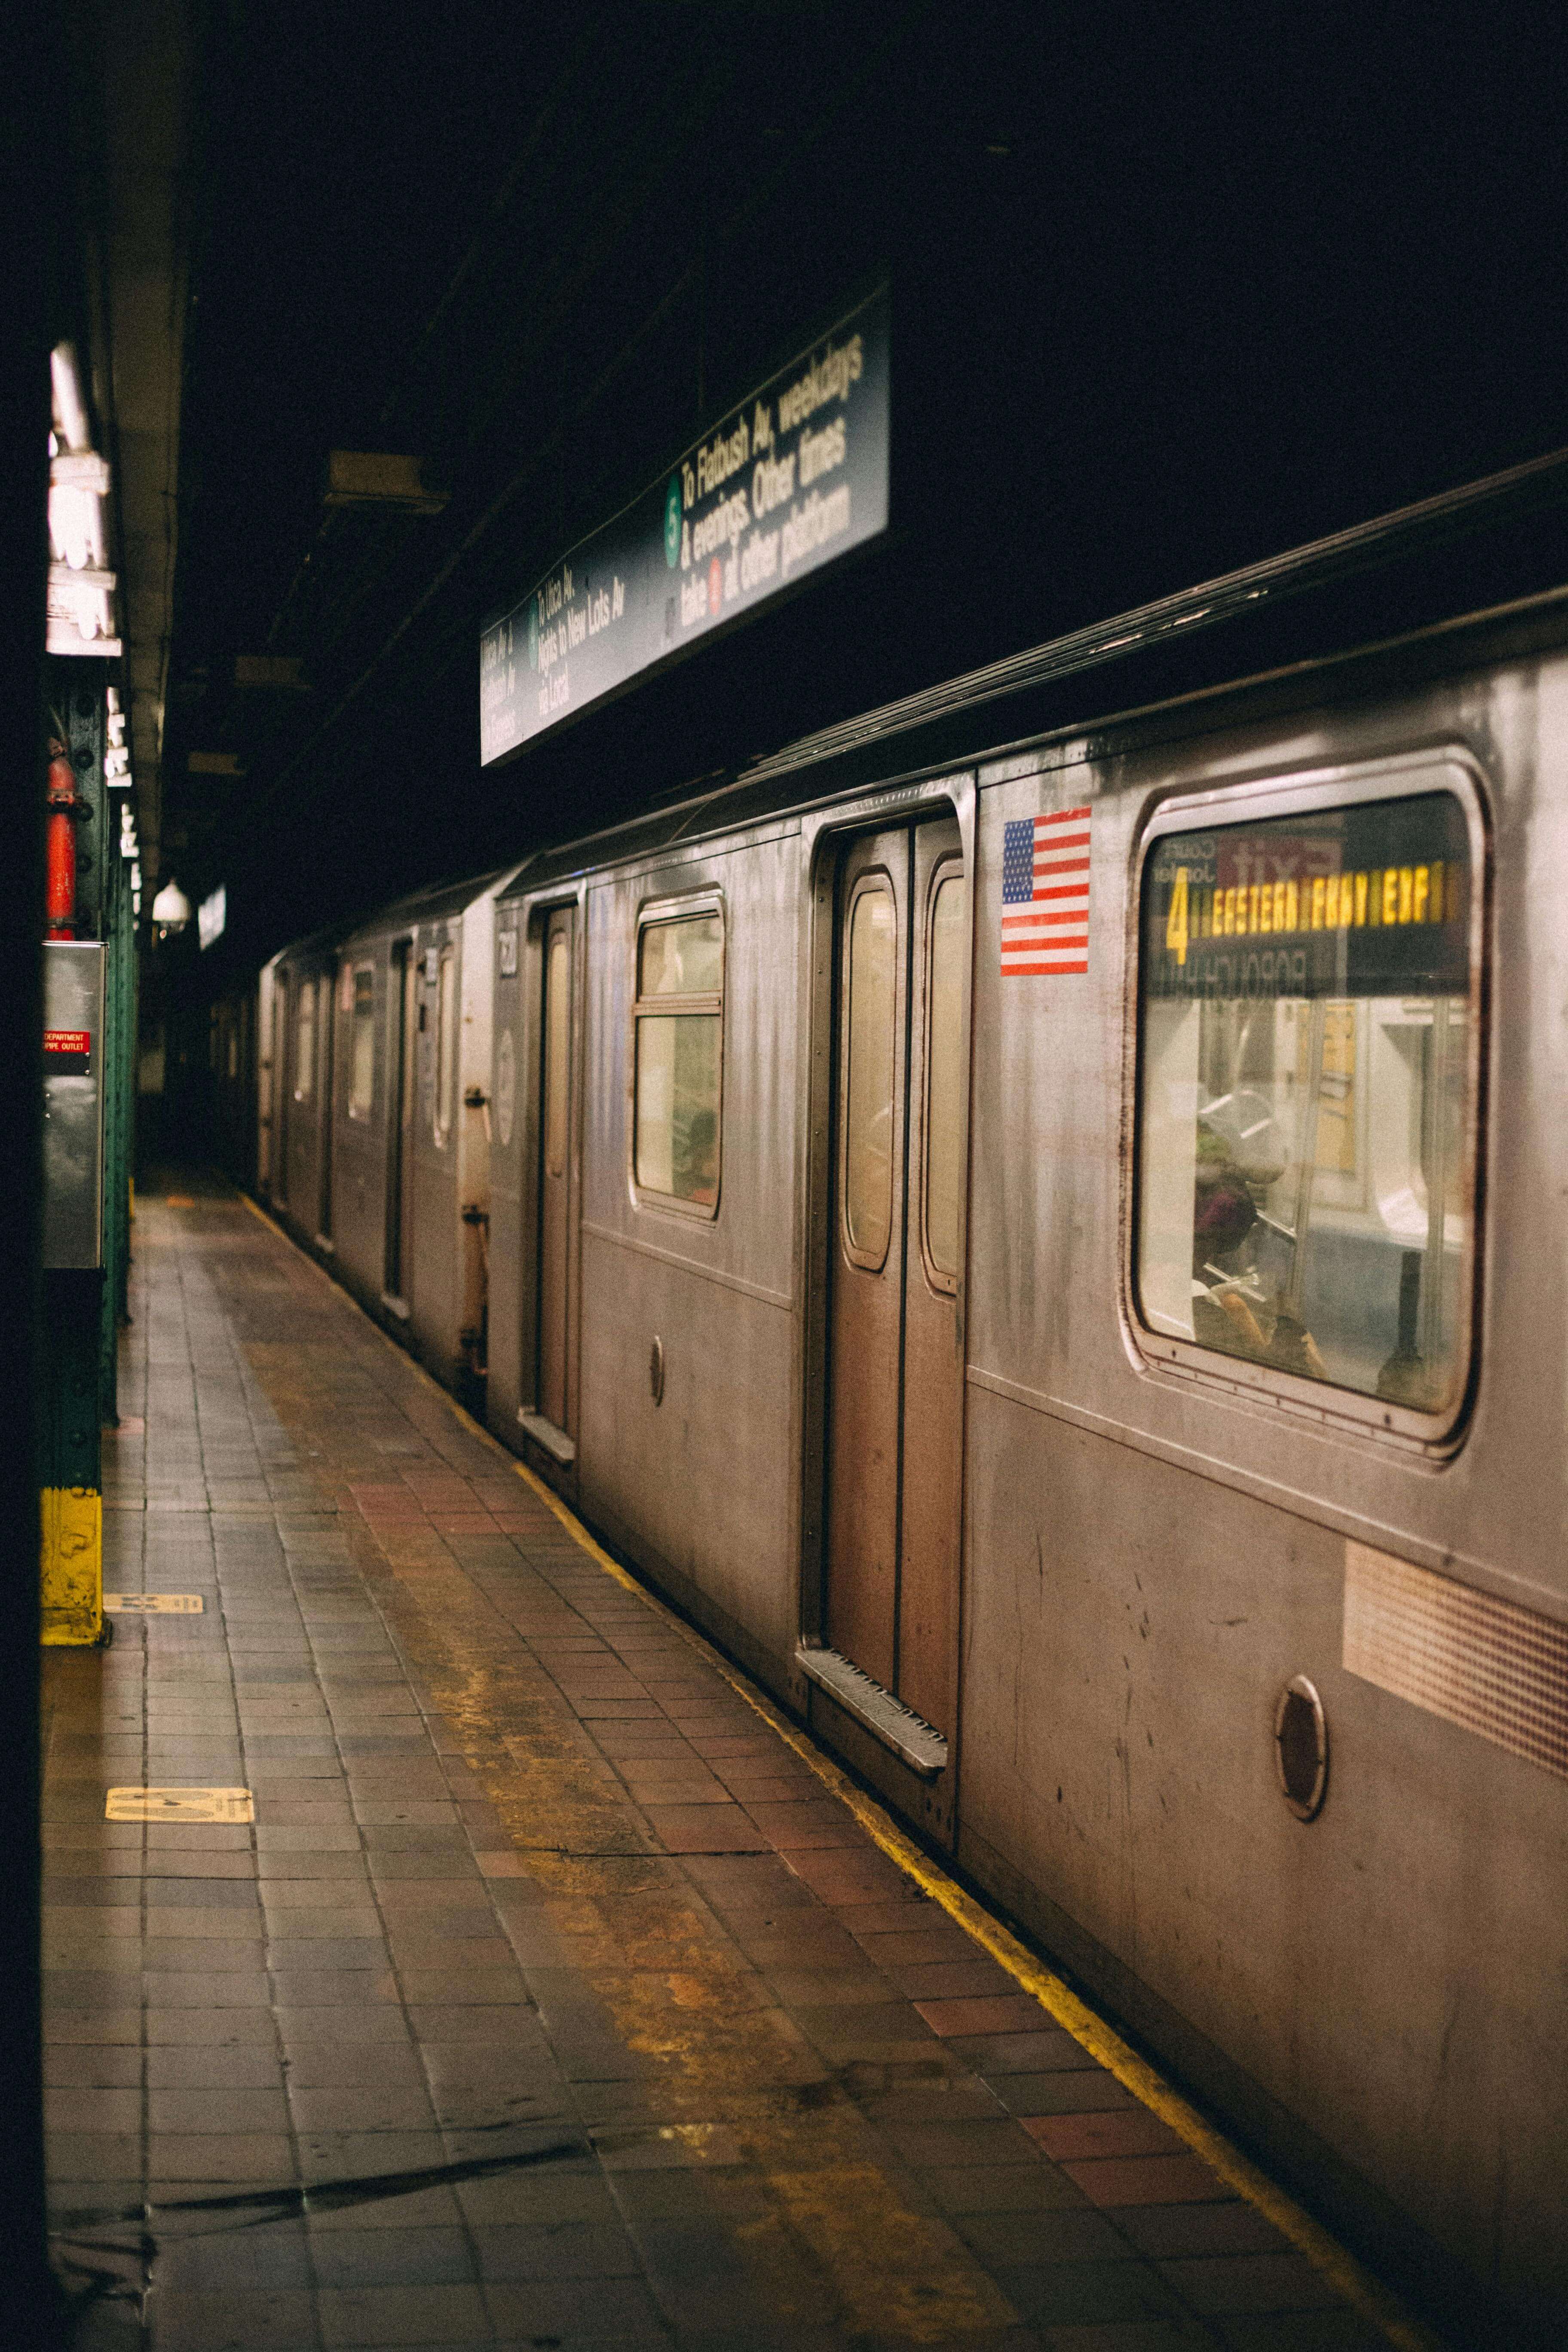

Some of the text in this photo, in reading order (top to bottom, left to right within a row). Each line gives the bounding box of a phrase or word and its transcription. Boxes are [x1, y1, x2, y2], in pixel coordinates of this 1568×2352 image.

[682, 462, 695, 511] To
[697, 413, 749, 499] Flatbush
[778, 335, 862, 433] weekdays
[753, 451, 795, 519] Other
[799, 416, 846, 487] times
[668, 495, 678, 548] 5
[537, 590, 545, 627] To
[558, 619, 567, 657] to
[567, 607, 586, 649] New
[588, 587, 610, 637] Lots
[612, 576, 625, 621] Av
[1166, 867, 1188, 966] 4
